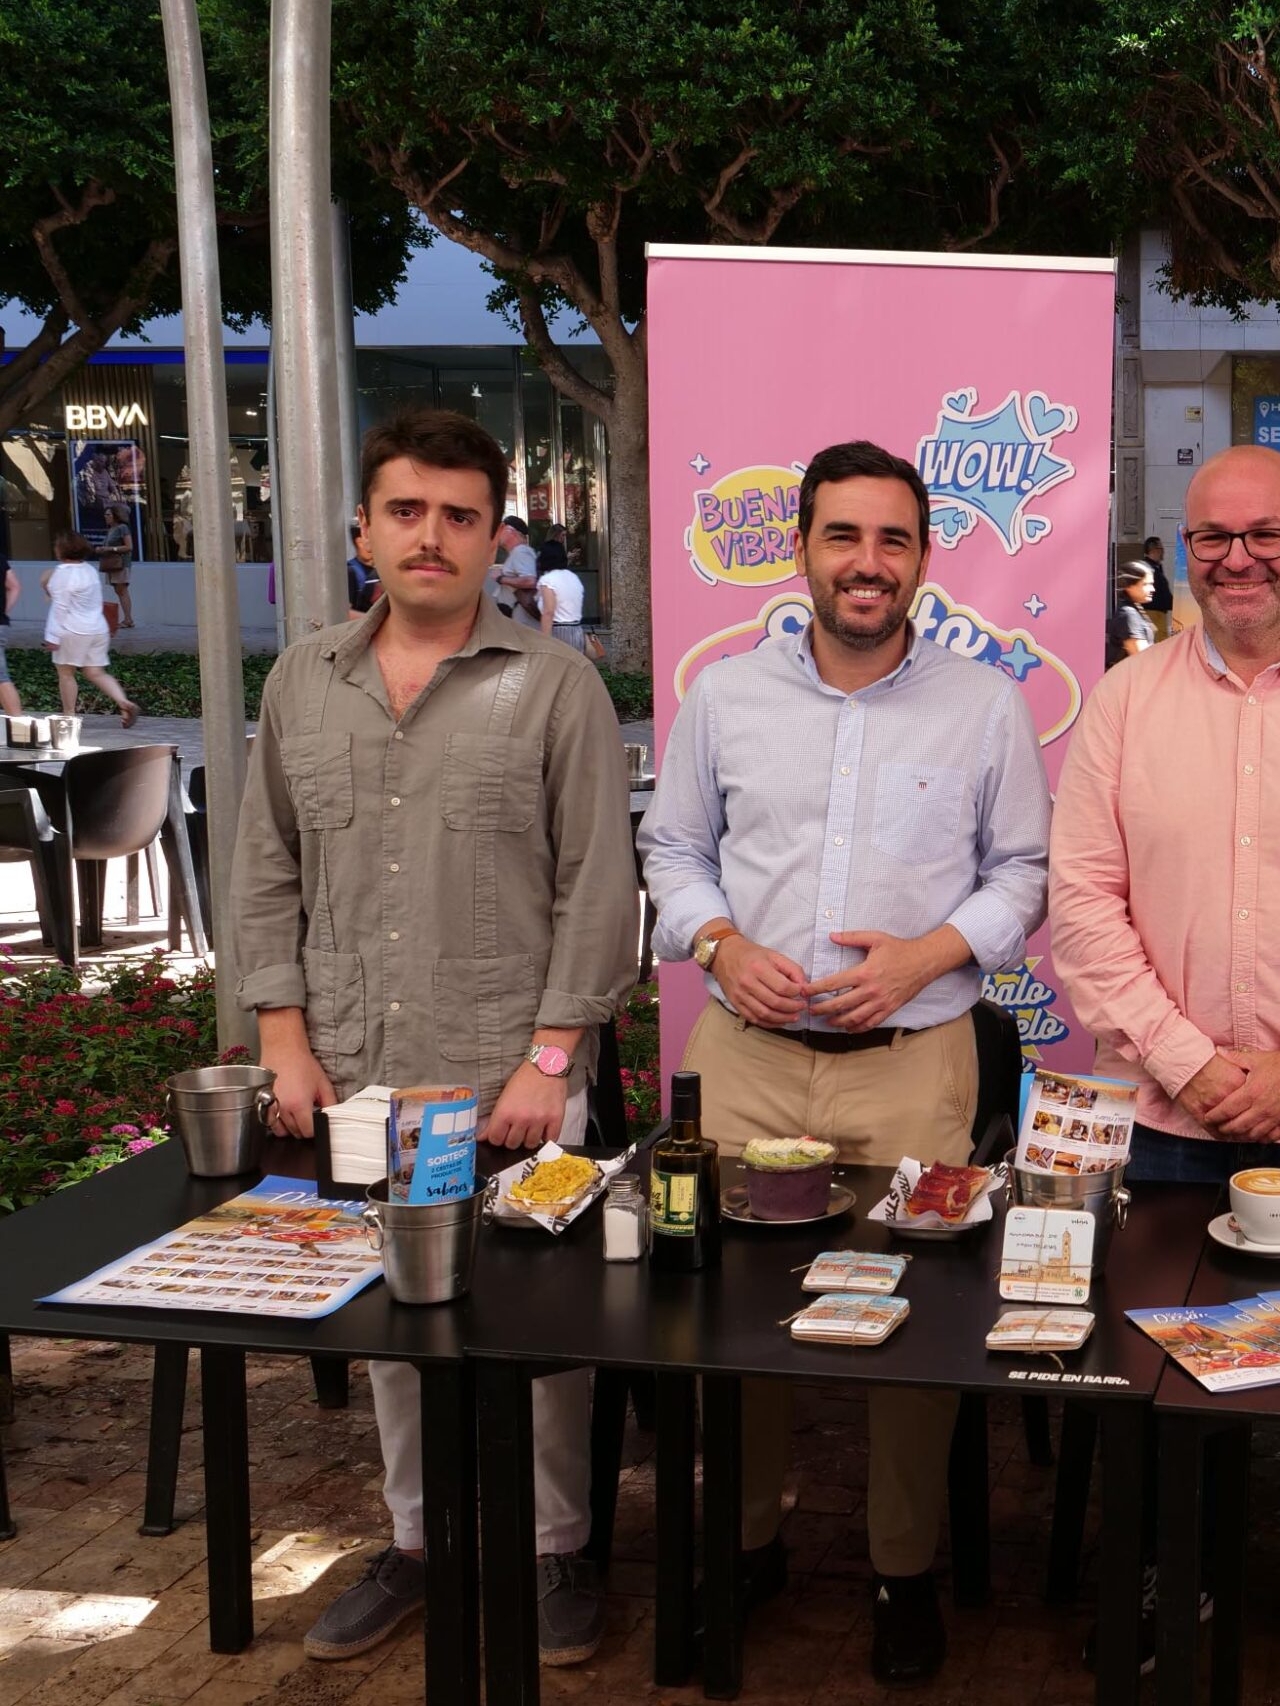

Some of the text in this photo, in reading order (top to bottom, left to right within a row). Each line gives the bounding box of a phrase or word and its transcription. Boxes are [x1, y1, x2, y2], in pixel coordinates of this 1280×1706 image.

[65, 403, 149, 430] BBVA
[920, 440, 1045, 494] WOW!
[427, 1146, 469, 1167] SORTEOS
[1008, 1371, 1027, 1380] SE
[1028, 1372, 1060, 1381] PIDE
[1061, 1374, 1082, 1383] EN
